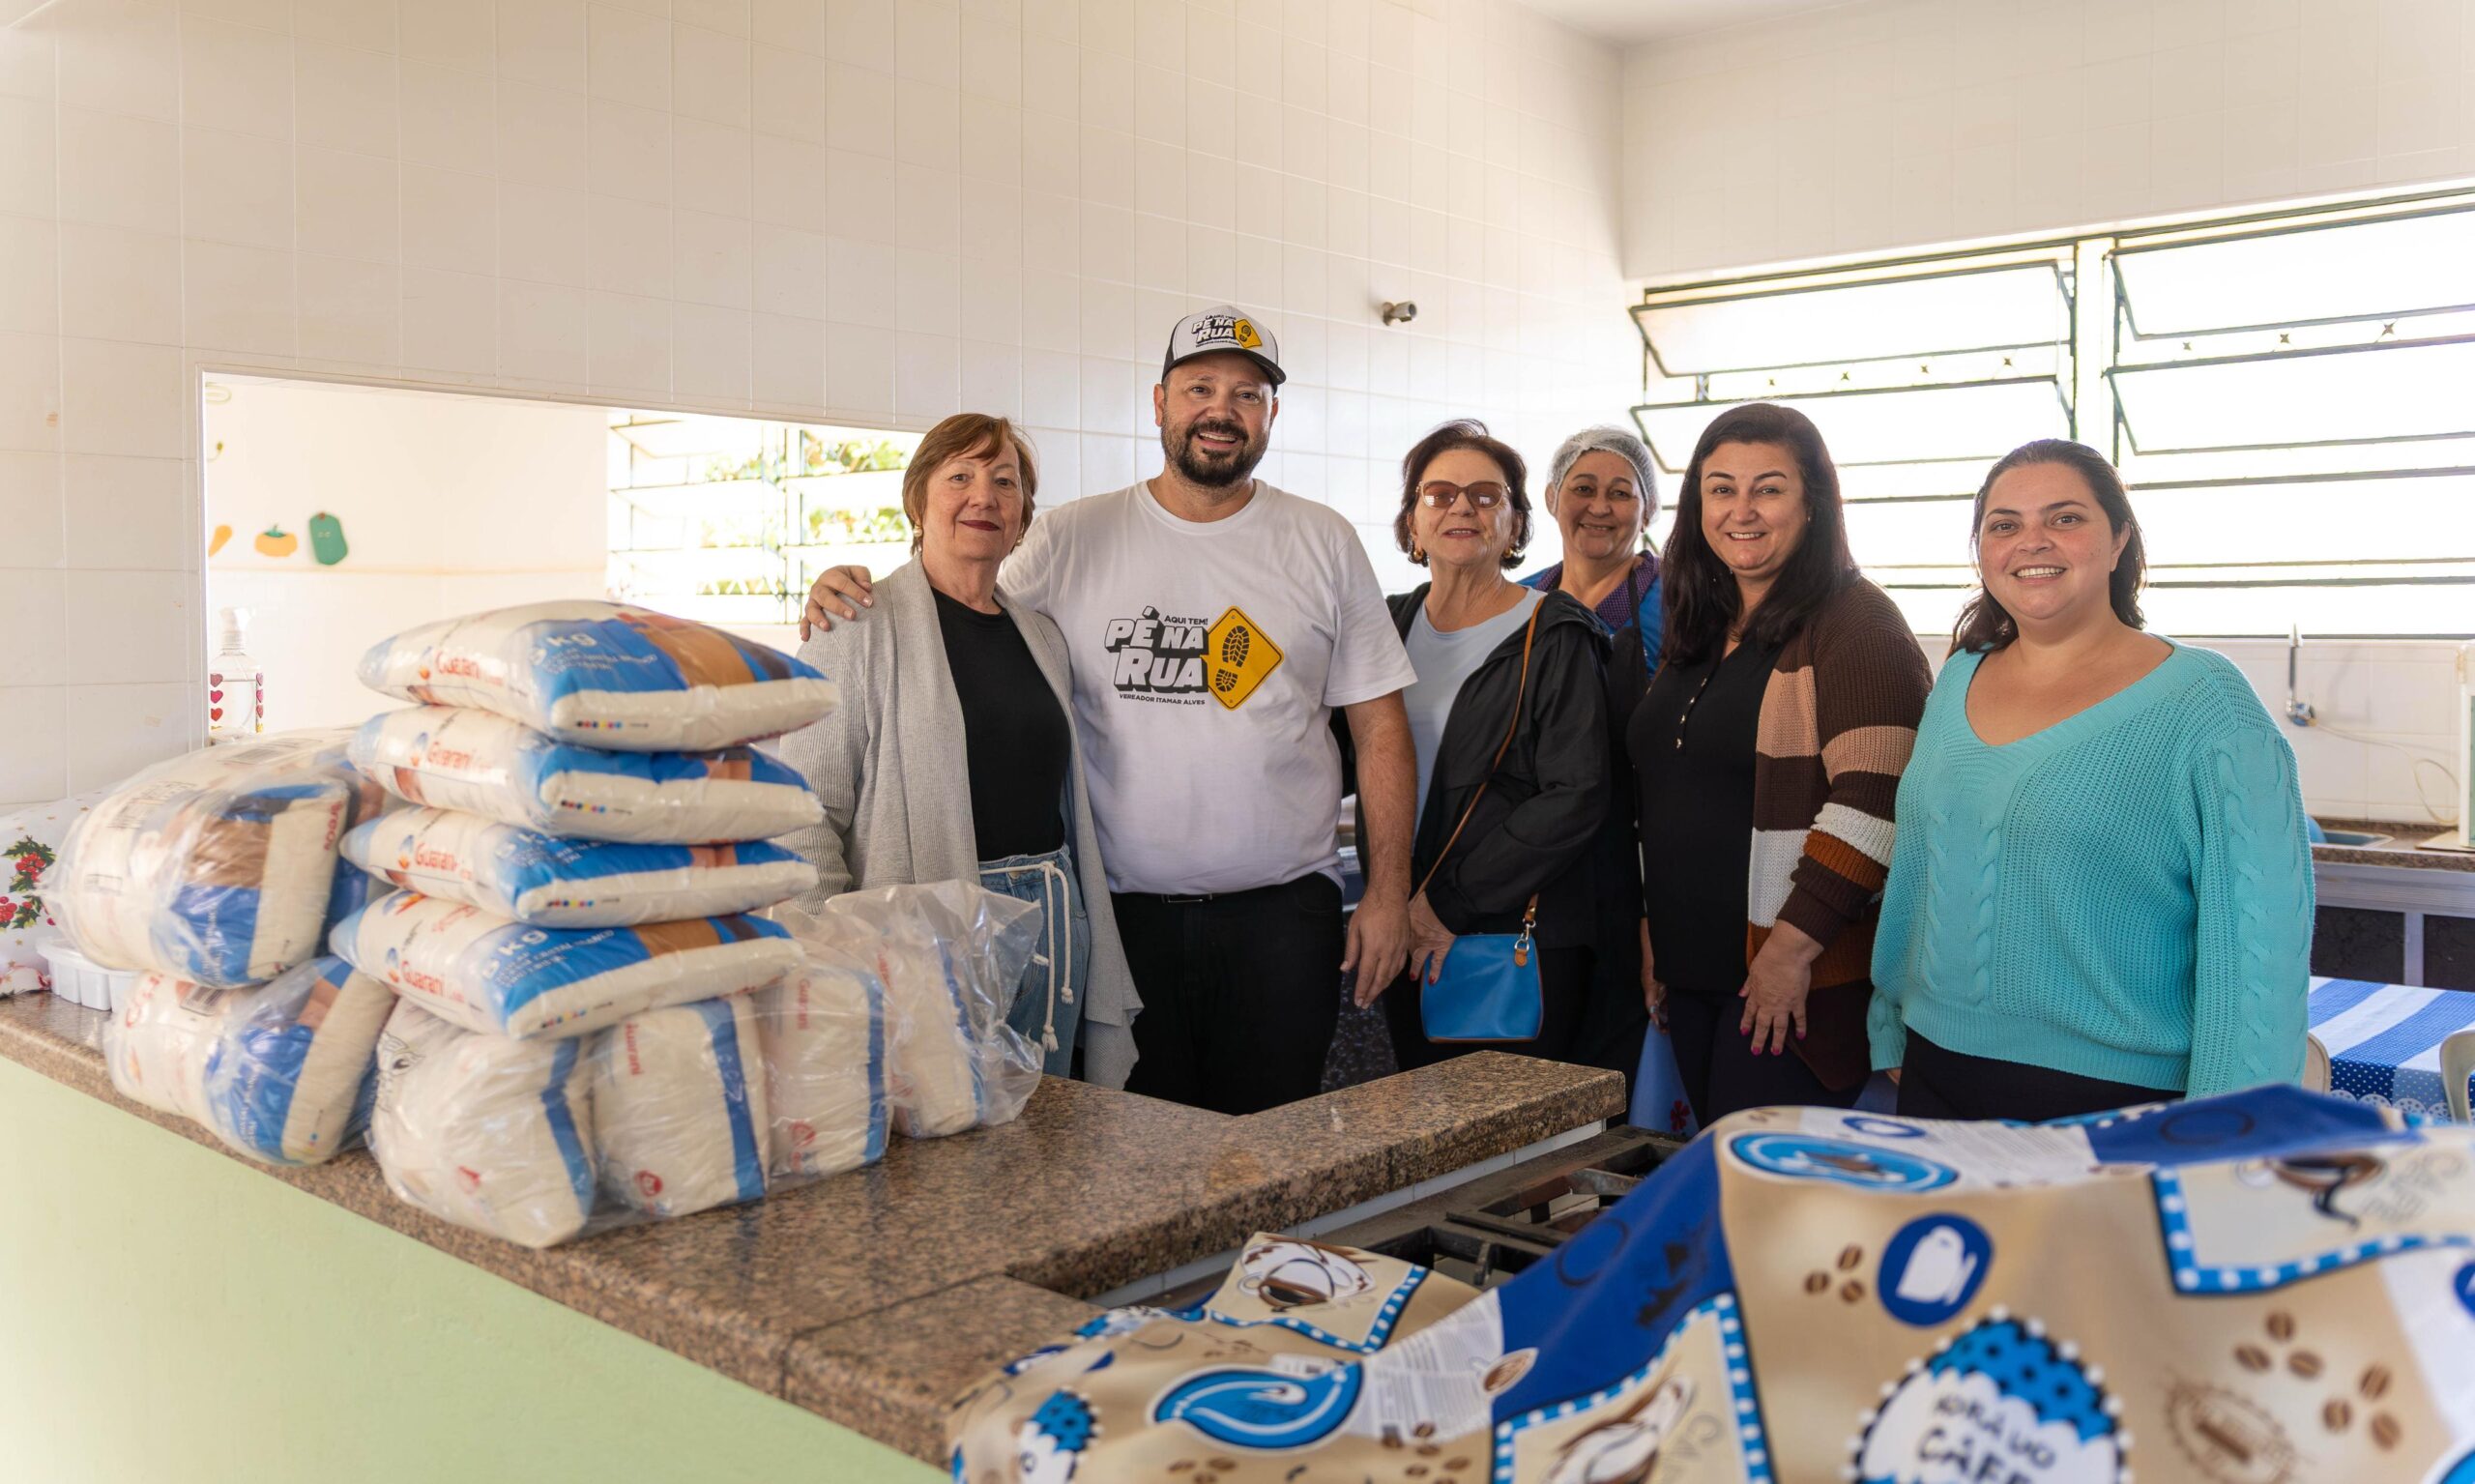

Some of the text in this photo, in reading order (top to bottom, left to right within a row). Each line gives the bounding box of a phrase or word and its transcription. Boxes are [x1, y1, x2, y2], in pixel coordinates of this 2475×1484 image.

[1212, 318, 1236, 329] NA
[1196, 327, 1237, 344] RUA
[1164, 615, 1208, 626] AQUI TEM!
[1104, 606, 1208, 654] PÉ NA
[1114, 647, 1208, 693] RUA
[1119, 693, 1155, 703] VEREADOR
